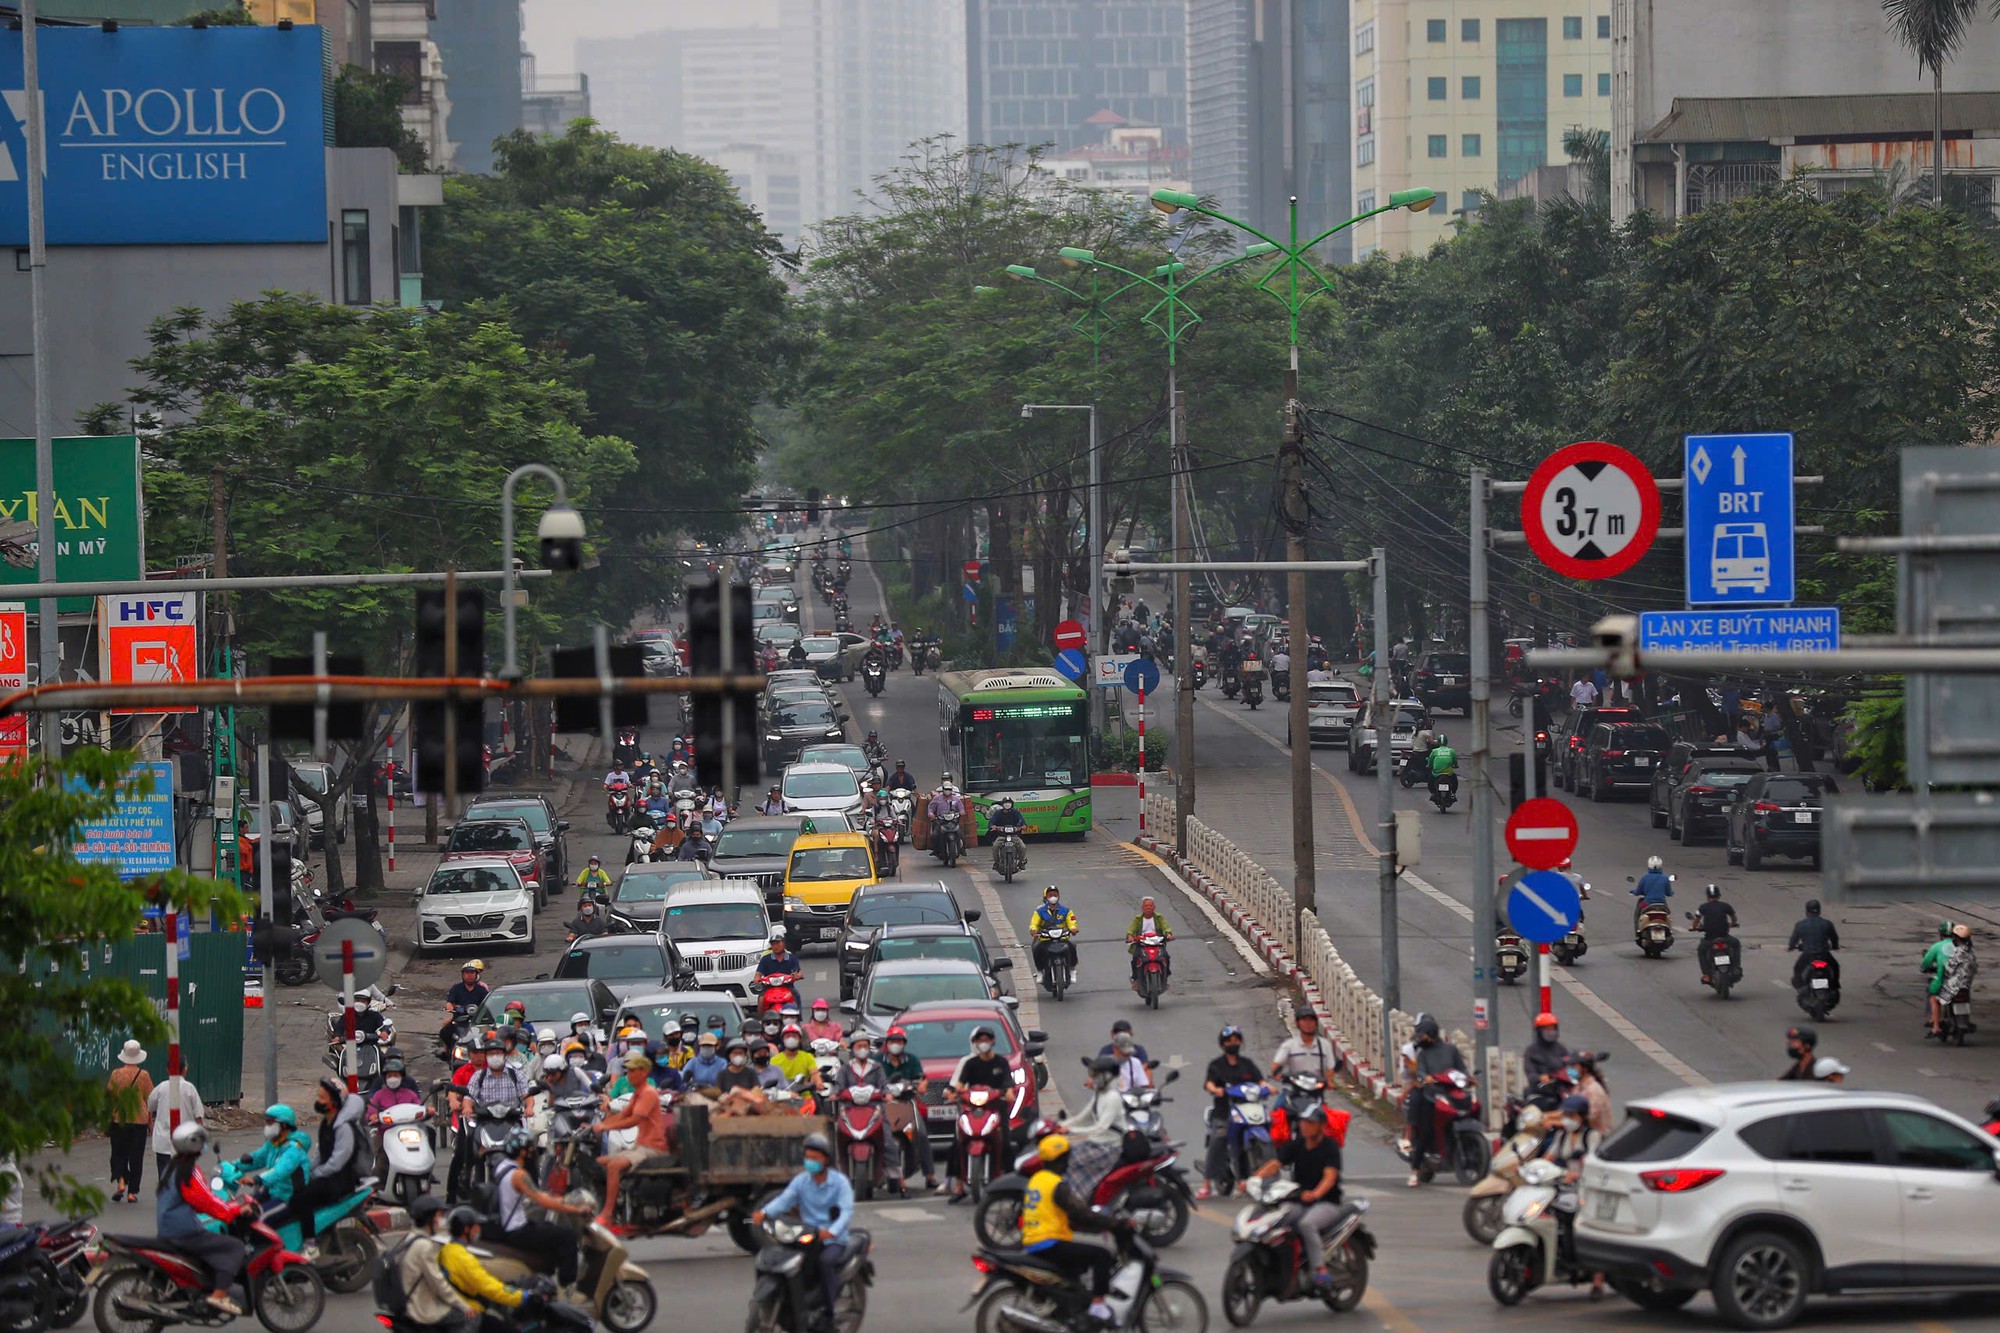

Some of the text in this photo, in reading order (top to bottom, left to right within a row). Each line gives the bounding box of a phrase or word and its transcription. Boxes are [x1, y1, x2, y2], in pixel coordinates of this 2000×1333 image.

[60, 88, 286, 136] APOLLO
[101, 152, 247, 180] ENGLISH
[1719, 492, 1764, 514] BRT
[120, 601, 184, 621] HFC
[1648, 614, 1832, 637] LÀN XE BUÝT NHANH
[1649, 641, 1676, 653] Bus
[1787, 637, 1831, 654] (BRT)
